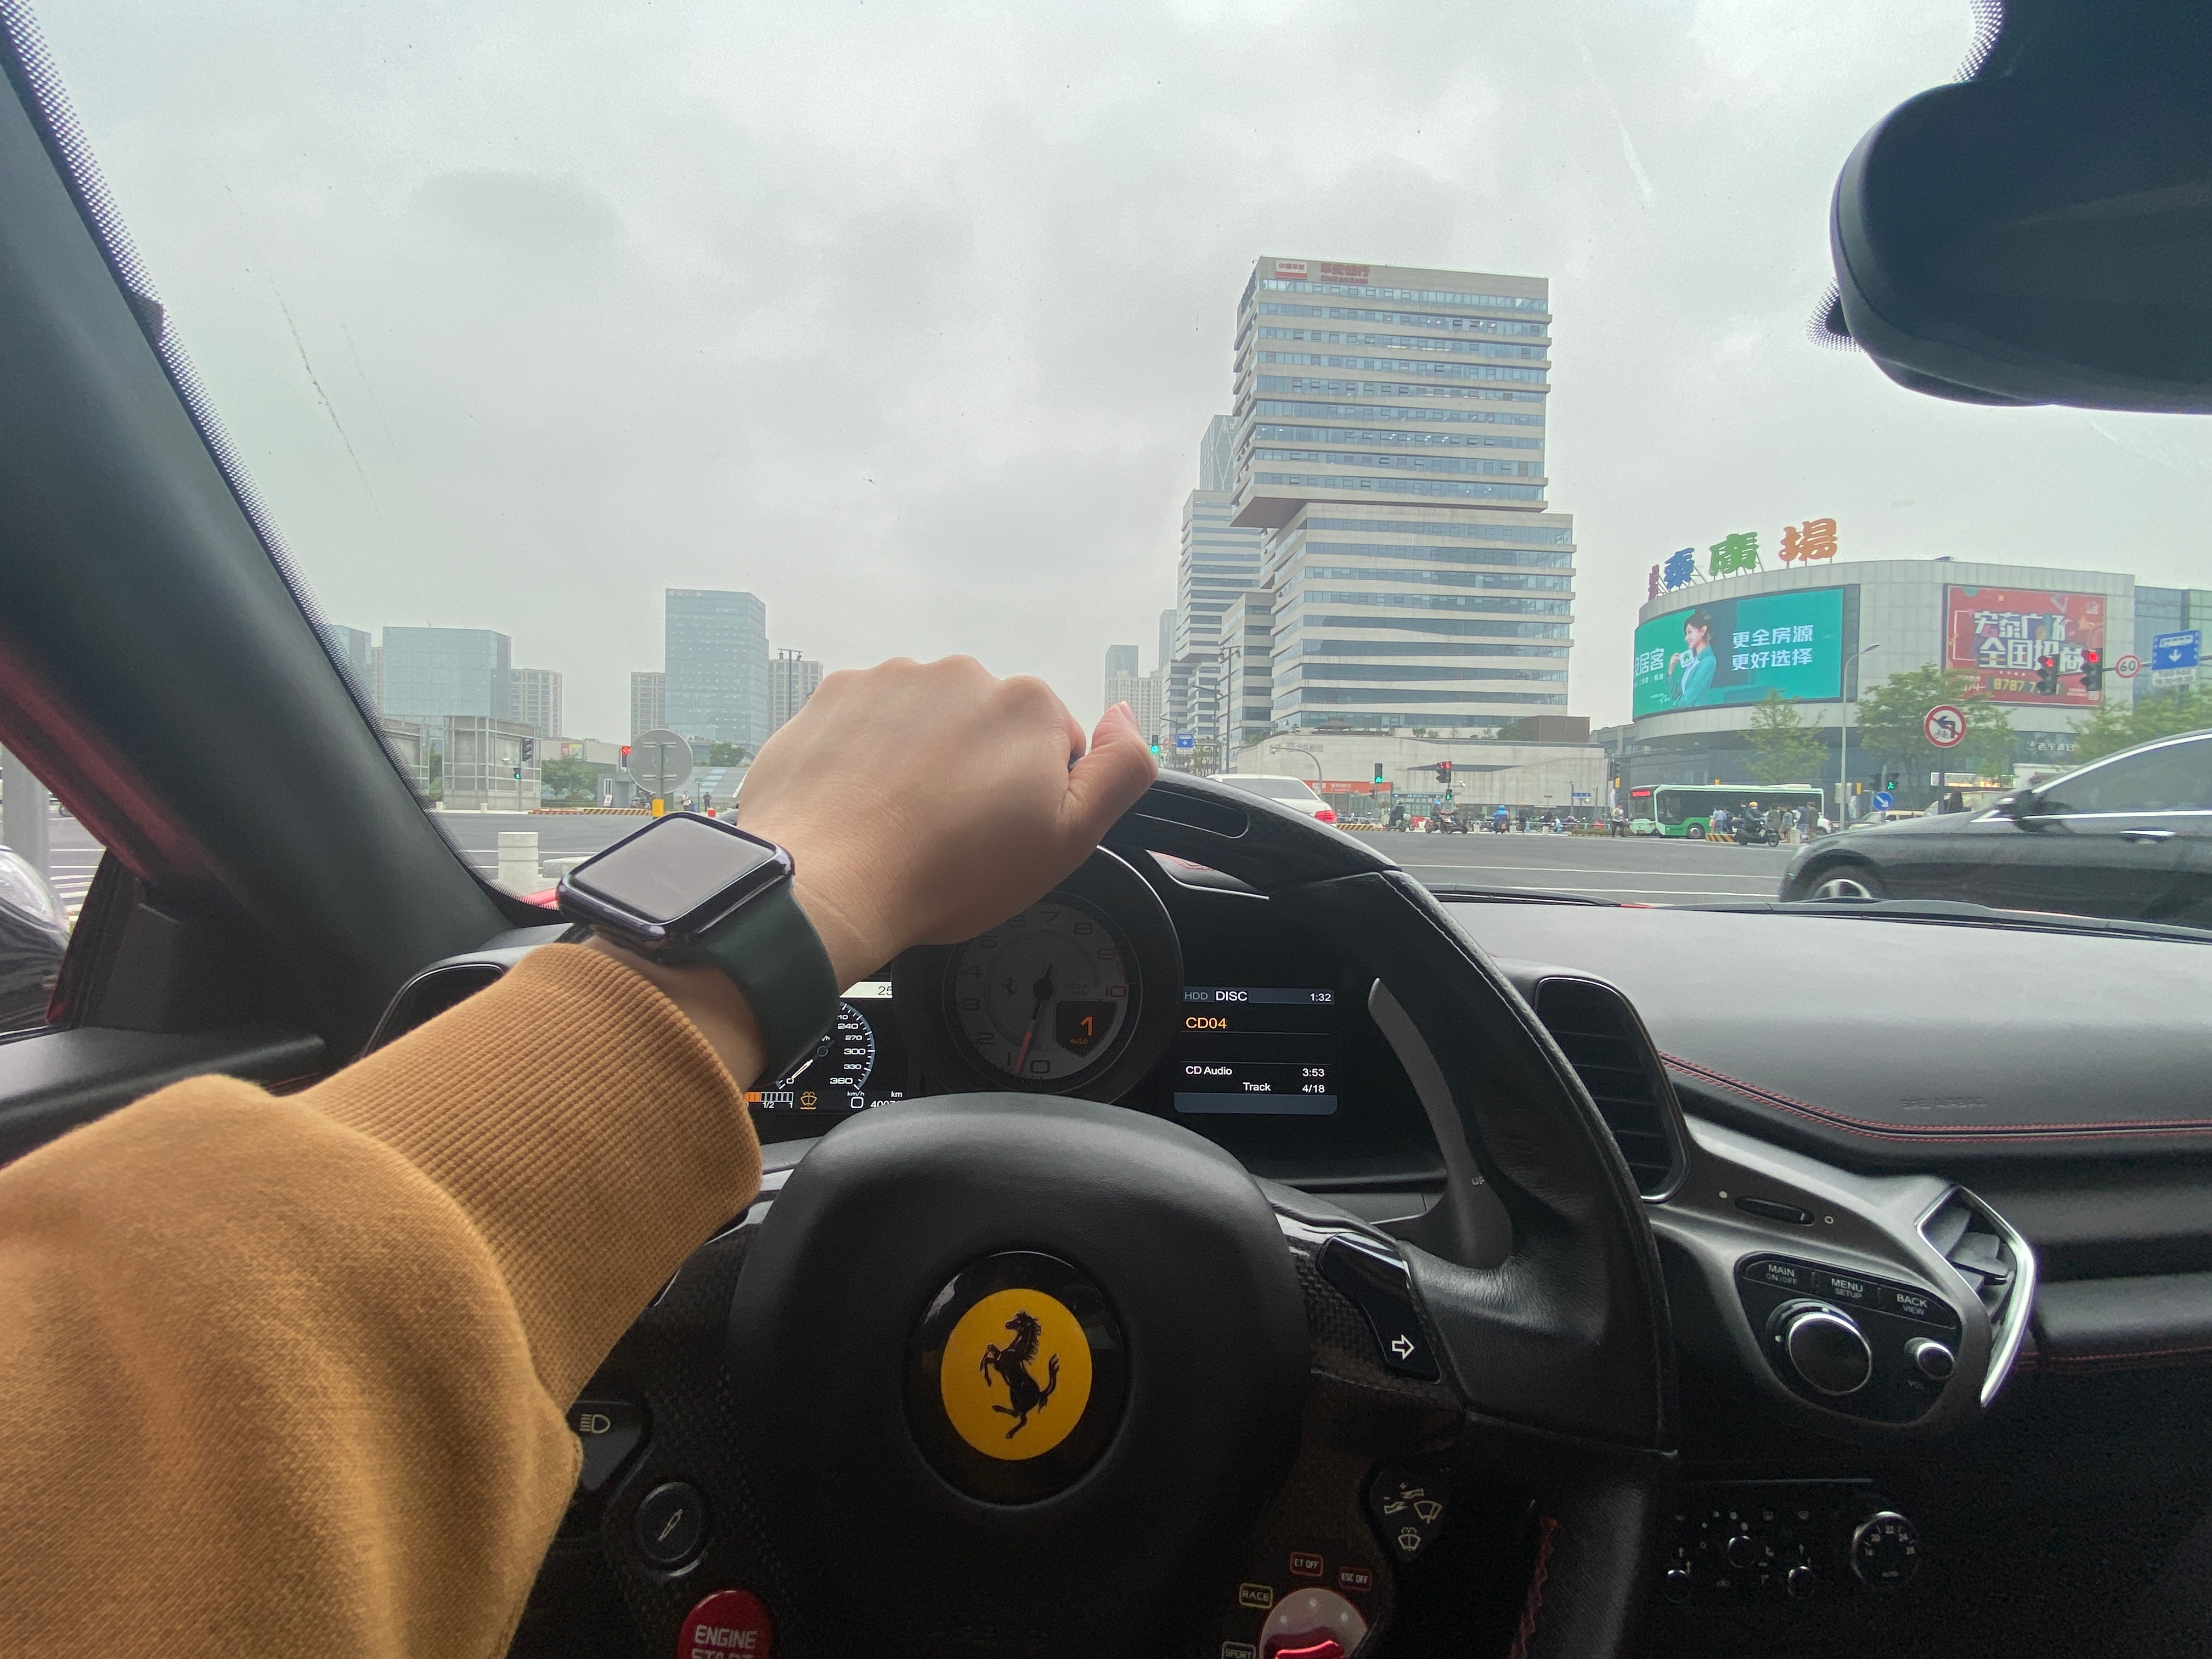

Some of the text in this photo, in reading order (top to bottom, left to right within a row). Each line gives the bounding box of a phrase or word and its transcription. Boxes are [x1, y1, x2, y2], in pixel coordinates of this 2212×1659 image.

[1732, 624, 1814, 650] 更全房源
[1731, 648, 1813, 672] 更好选择
[2120, 660, 2136, 672] 60
[1184, 991, 1331, 1002] HDD DISC 1:32
[1081, 1017, 1092, 1036] 1
[1186, 1017, 1227, 1029] CD04
[1186, 1066, 1325, 1077] CD Audio 3:53
[1243, 1082, 1325, 1093] Track 4/18
[851, 1097, 864, 1108] 0
[1471, 1176, 1485, 1185] UP
[1768, 1264, 1795, 1277] MAIN
[1831, 1278, 1864, 1293] MENU
[1835, 1287, 1863, 1299] SETUP
[1896, 1293, 1928, 1308] BACK
[1902, 1305, 1926, 1316] VIEW
[1295, 1558, 1319, 1569] CT OFF
[1356, 1575, 1369, 1584] OFF
[1242, 1591, 1269, 1601] RACE
[695, 1624, 758, 1649] ENGINE
